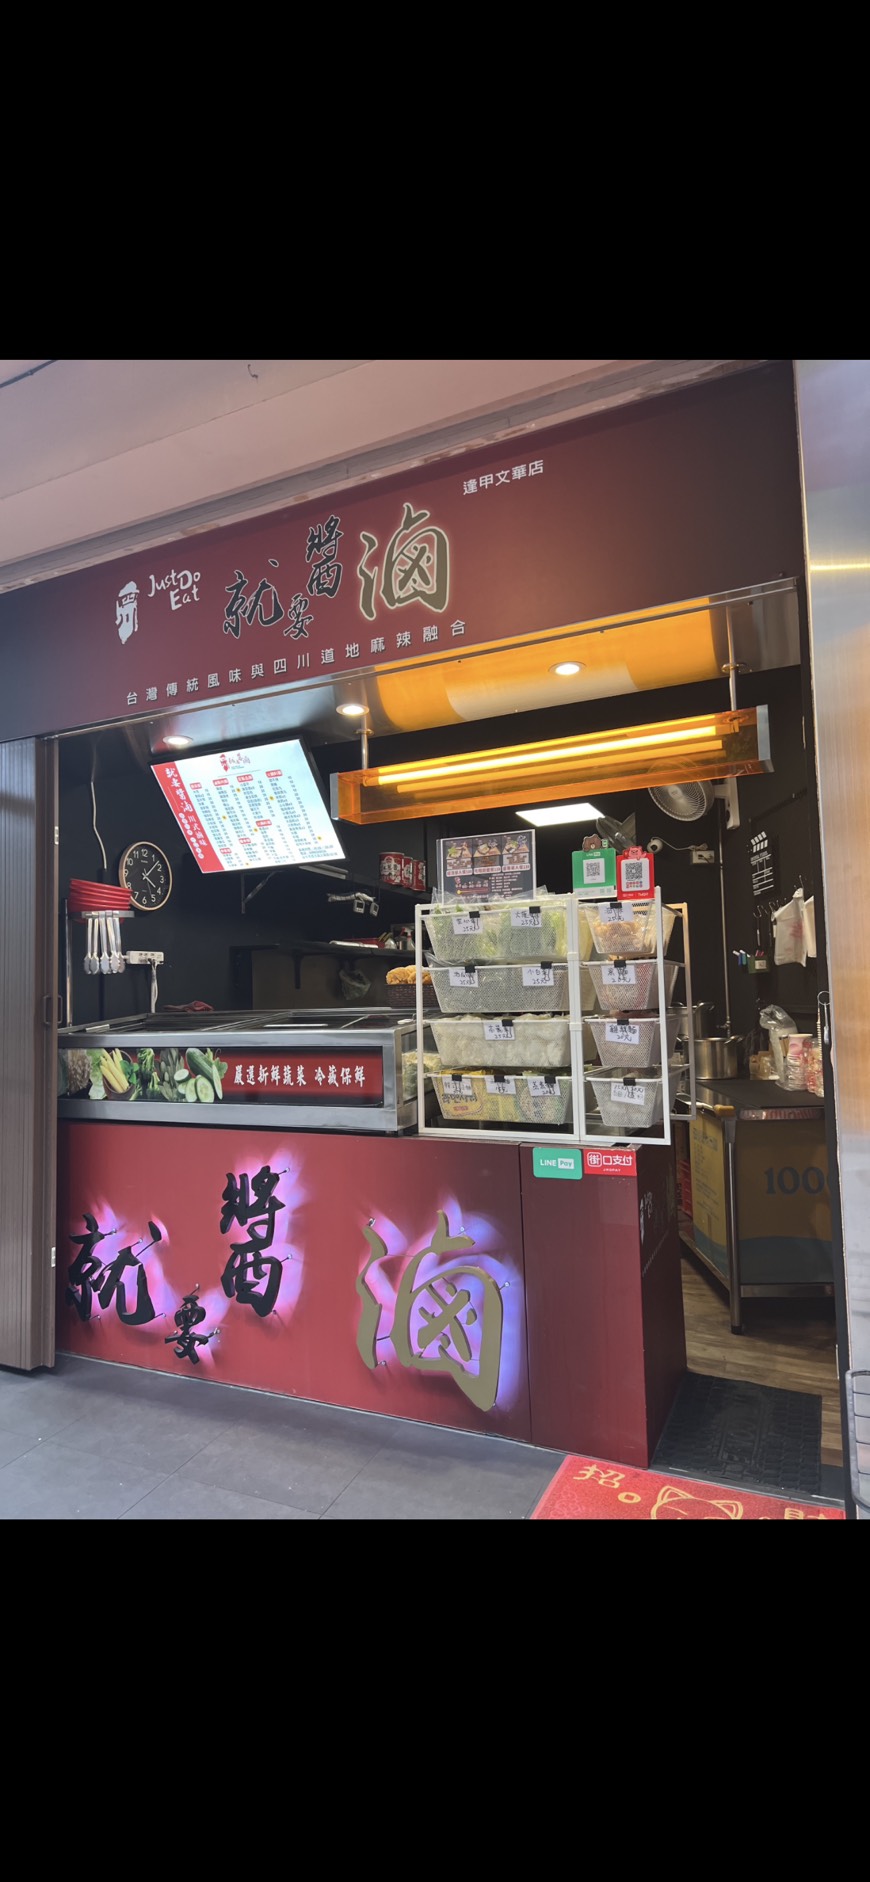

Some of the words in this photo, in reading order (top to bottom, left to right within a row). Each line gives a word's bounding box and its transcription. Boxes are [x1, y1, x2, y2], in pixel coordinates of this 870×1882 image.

[463, 459, 544, 495] 逢甲文華店
[148, 569, 178, 597] Just
[177, 570, 201, 590] Do
[169, 584, 200, 611] Eat
[126, 618, 466, 706] 台灣傳統風味與四川道地麻辣融合
[133, 850, 139, 859] 11
[141, 848, 149, 858] 12
[127, 858, 134, 866] 10
[151, 854, 155, 862] 1
[157, 863, 162, 872] 2
[159, 875, 165, 884] 3
[134, 891, 139, 900] 7
[156, 887, 162, 895] 4
[142, 896, 147, 904] 6
[151, 894, 156, 902] 5
[234, 1064, 307, 1087] 嚴選新鮮蔬菜
[314, 1064, 366, 1088] 冷藏保鮮
[540, 1158, 557, 1167] LINE
[559, 1160, 573, 1168] Pay
[588, 1153, 633, 1166] 街口支付
